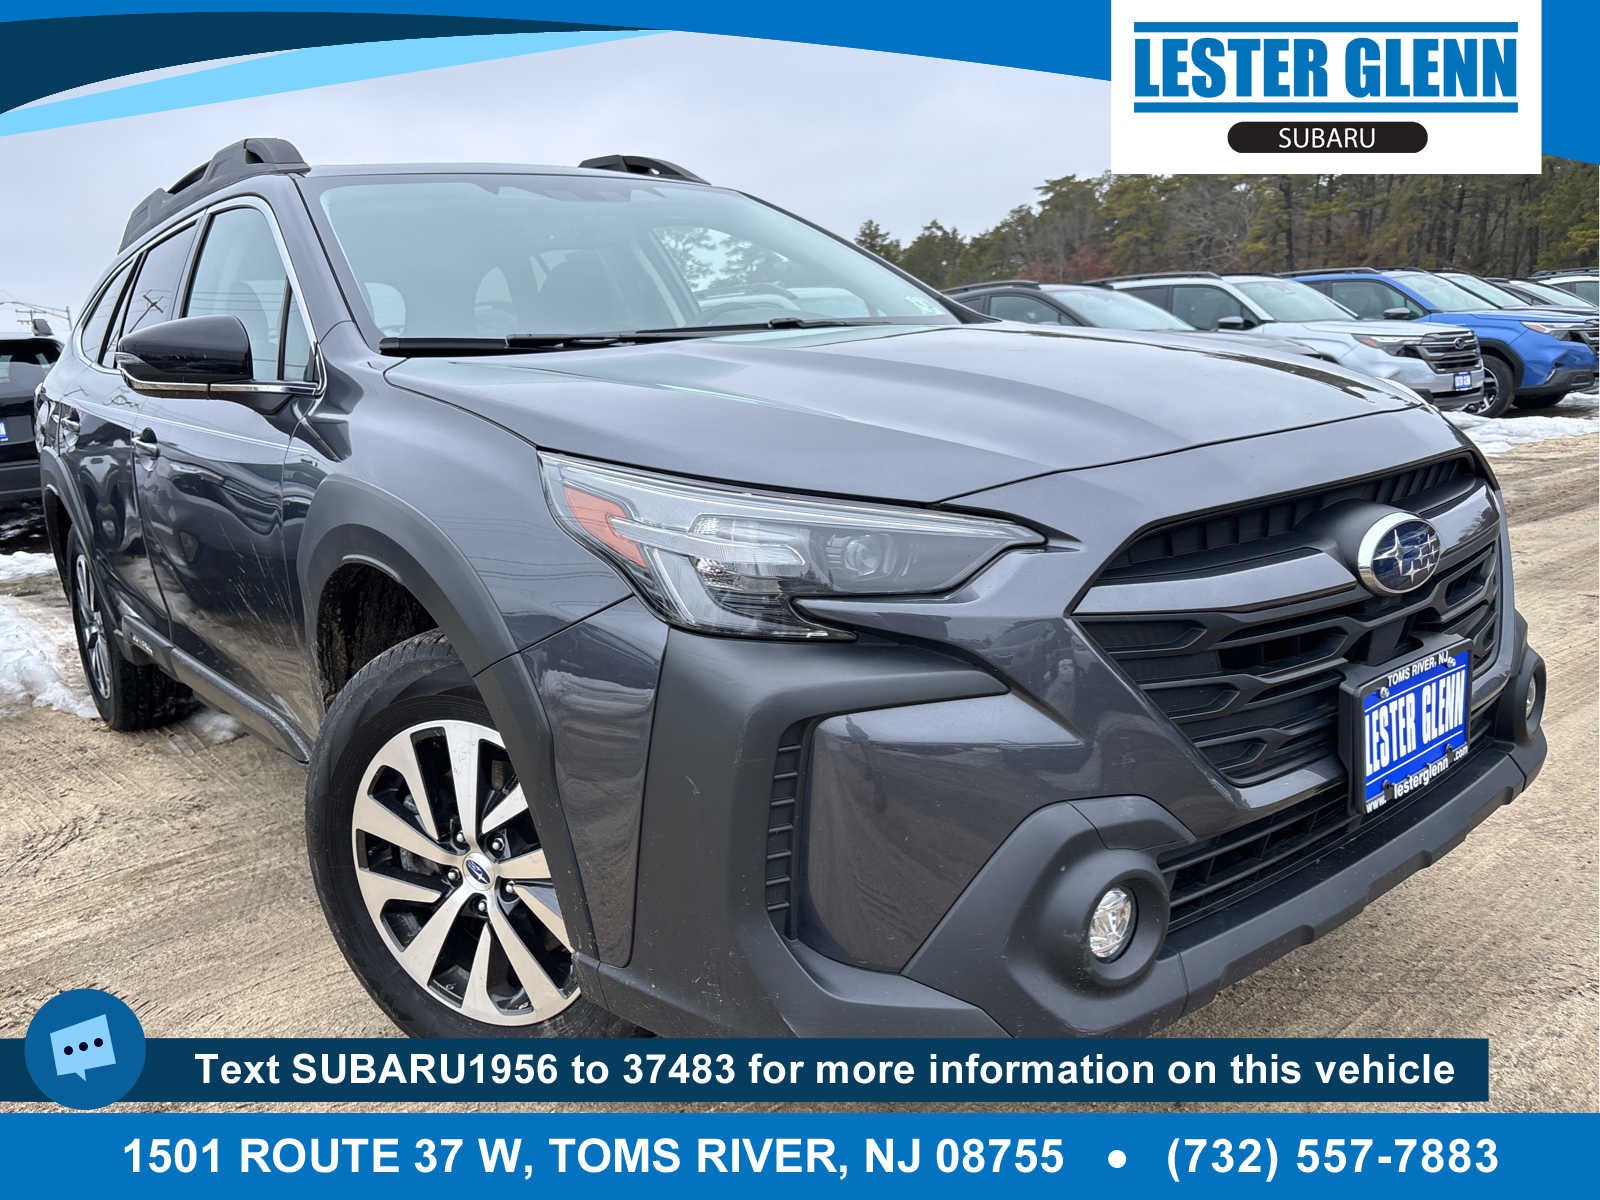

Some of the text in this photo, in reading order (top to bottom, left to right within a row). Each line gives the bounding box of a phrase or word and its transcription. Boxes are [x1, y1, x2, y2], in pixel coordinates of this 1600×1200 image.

[1387, 650, 1449, 687] TOMS RIVER, NJ
[1364, 669, 1465, 777] LESTER GLENN
